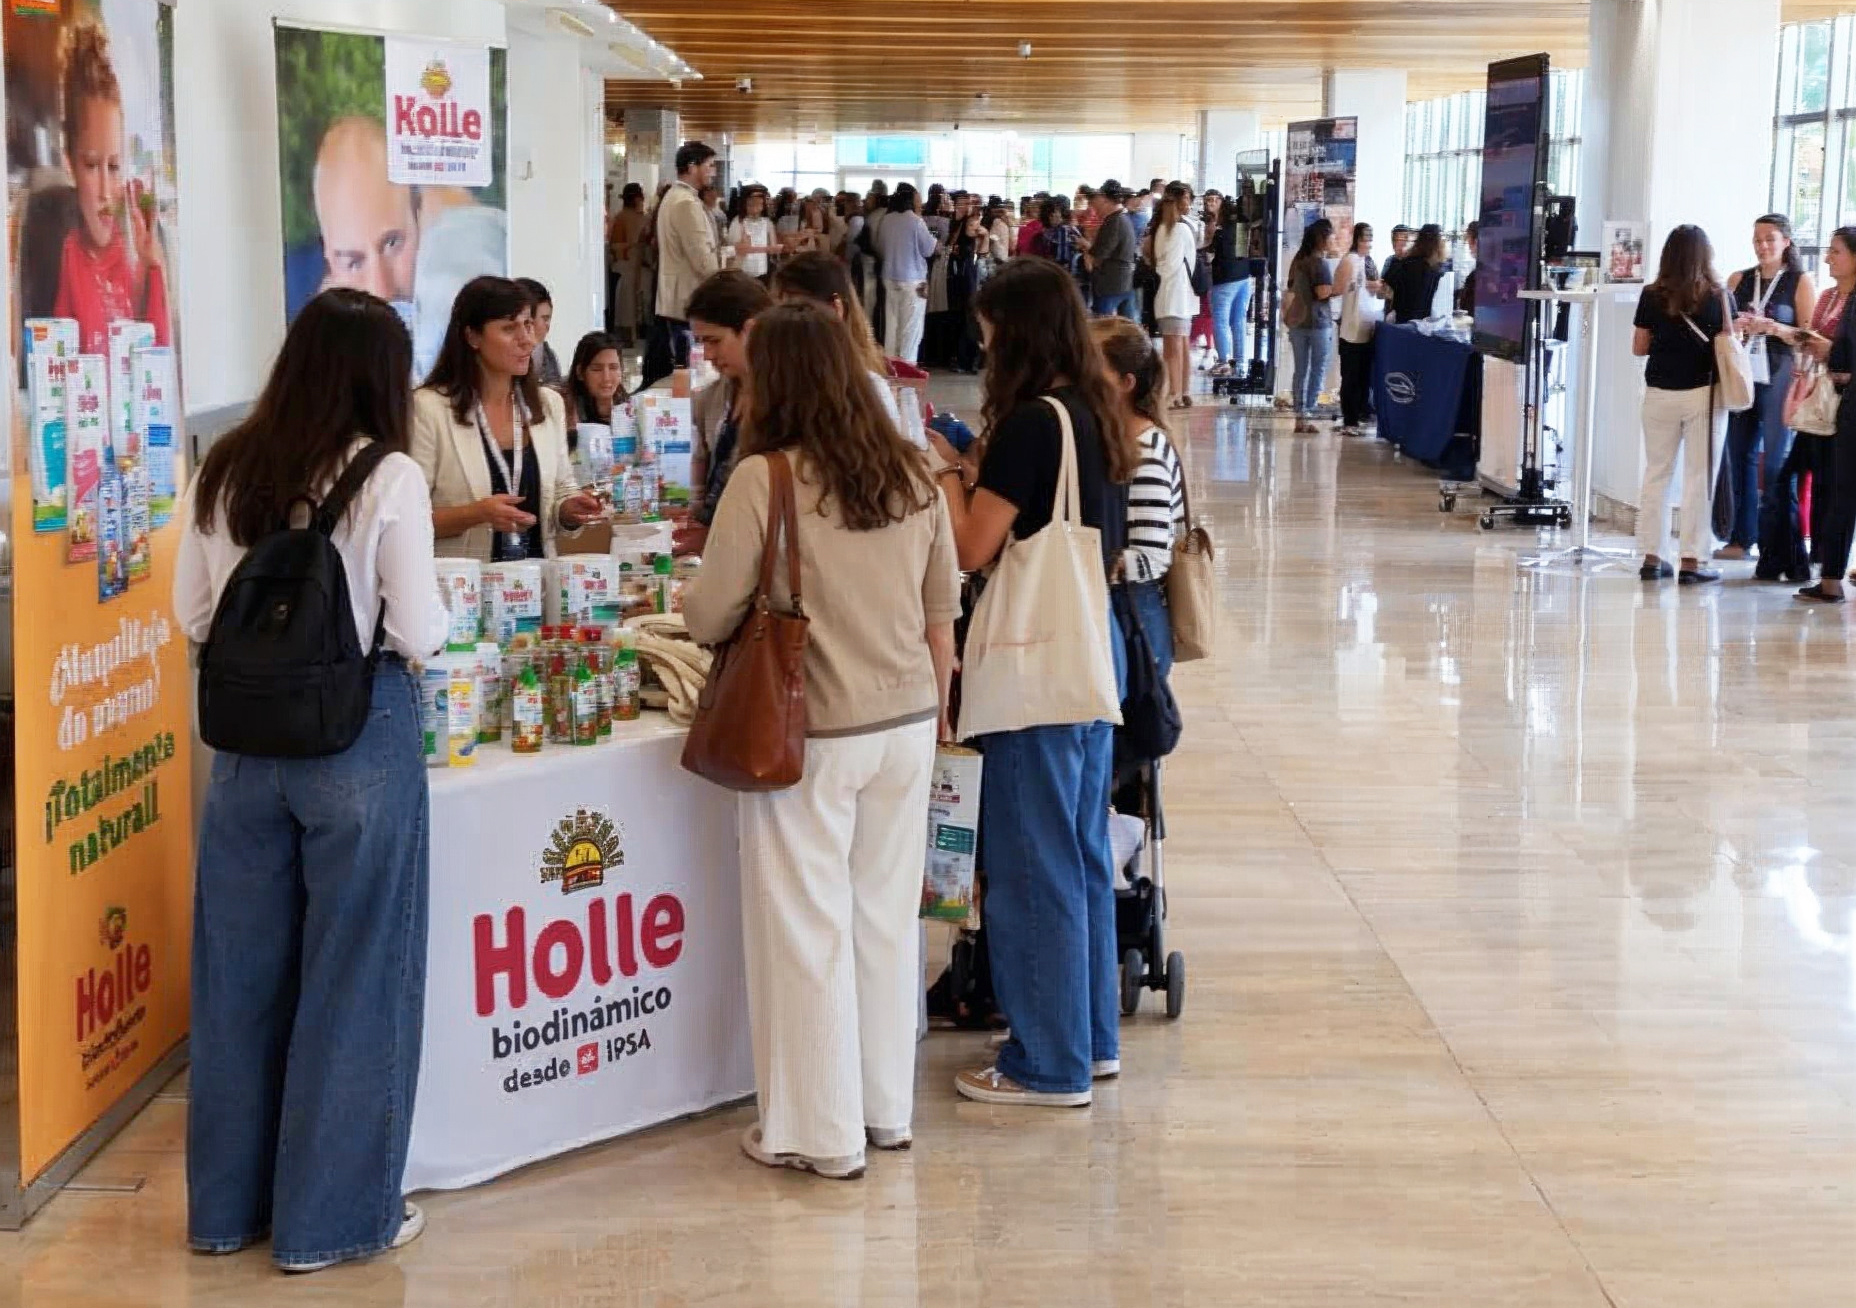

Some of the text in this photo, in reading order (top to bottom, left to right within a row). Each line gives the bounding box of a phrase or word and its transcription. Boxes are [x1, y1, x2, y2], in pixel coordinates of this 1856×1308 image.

[76, 942, 151, 1042] Holle
[474, 893, 684, 1017] Holle
[492, 985, 671, 1060] biodinámico
[606, 1028, 651, 1062] IPSA
